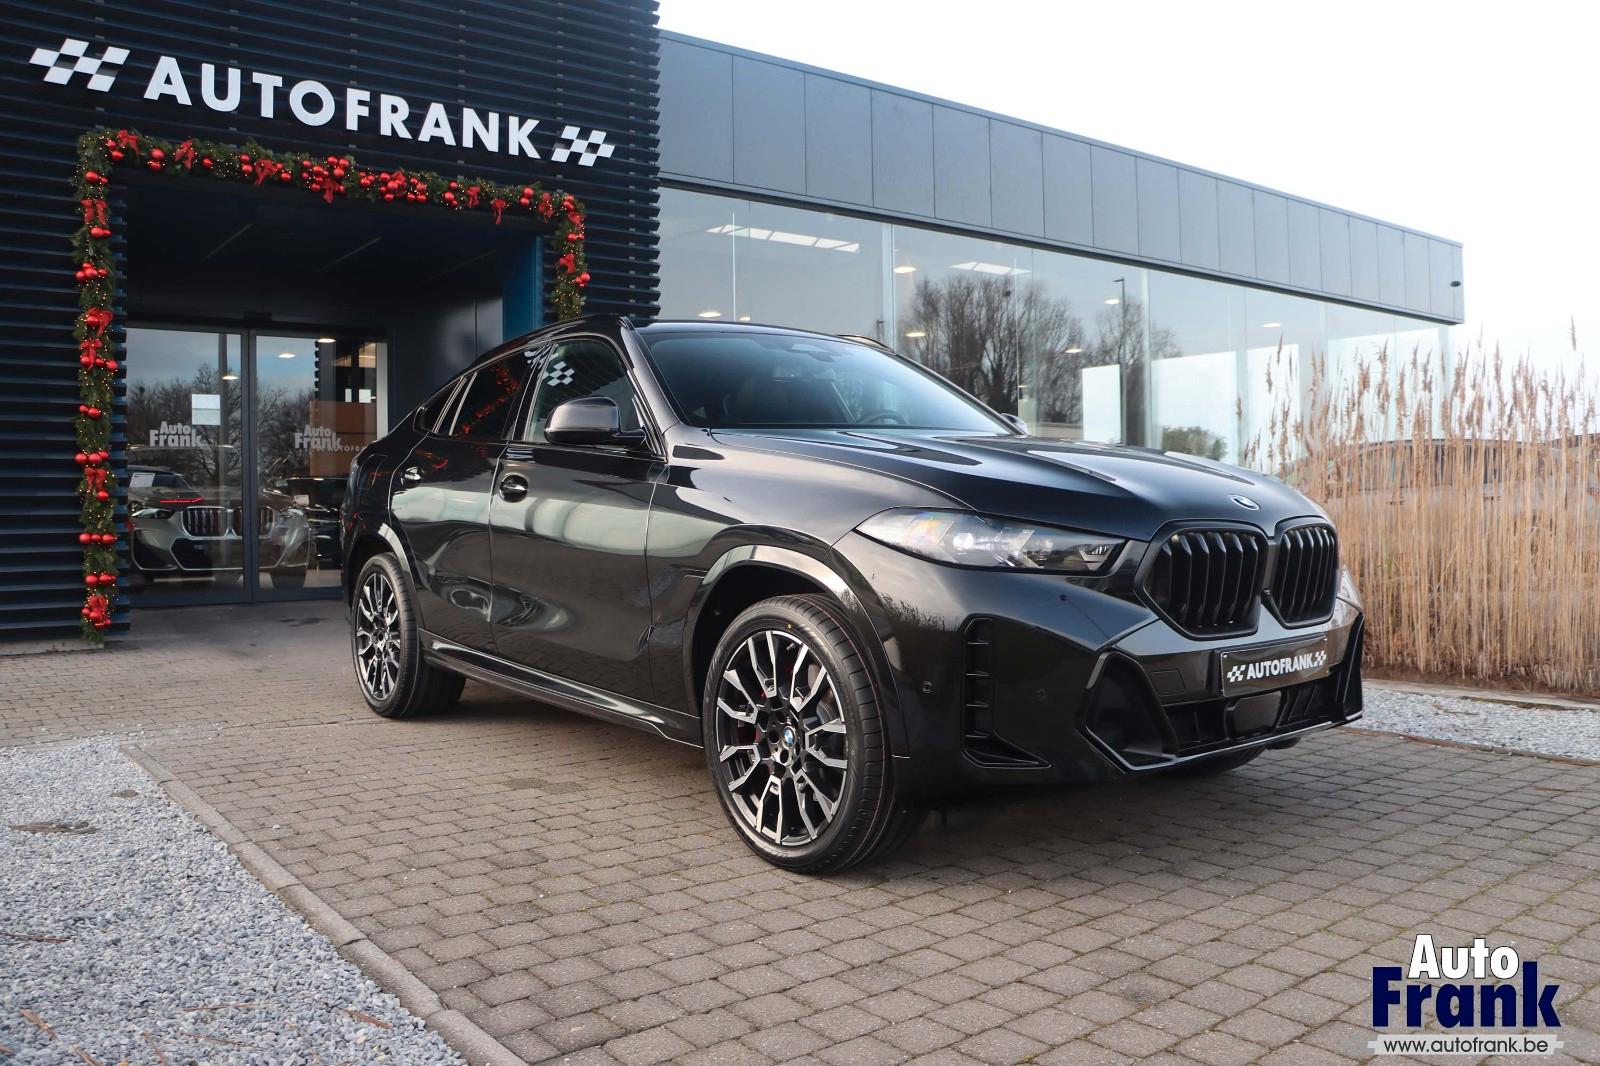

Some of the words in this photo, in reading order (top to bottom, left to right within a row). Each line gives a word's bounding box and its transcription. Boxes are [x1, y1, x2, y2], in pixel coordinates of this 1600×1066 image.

[143, 55, 542, 160] AUTOFRANK
[160, 421, 191, 435] Auto
[303, 424, 332, 438] Auto
[149, 428, 202, 448] Frank
[294, 432, 341, 449] Frank
[1246, 652, 1315, 680] AUTOFRANK
